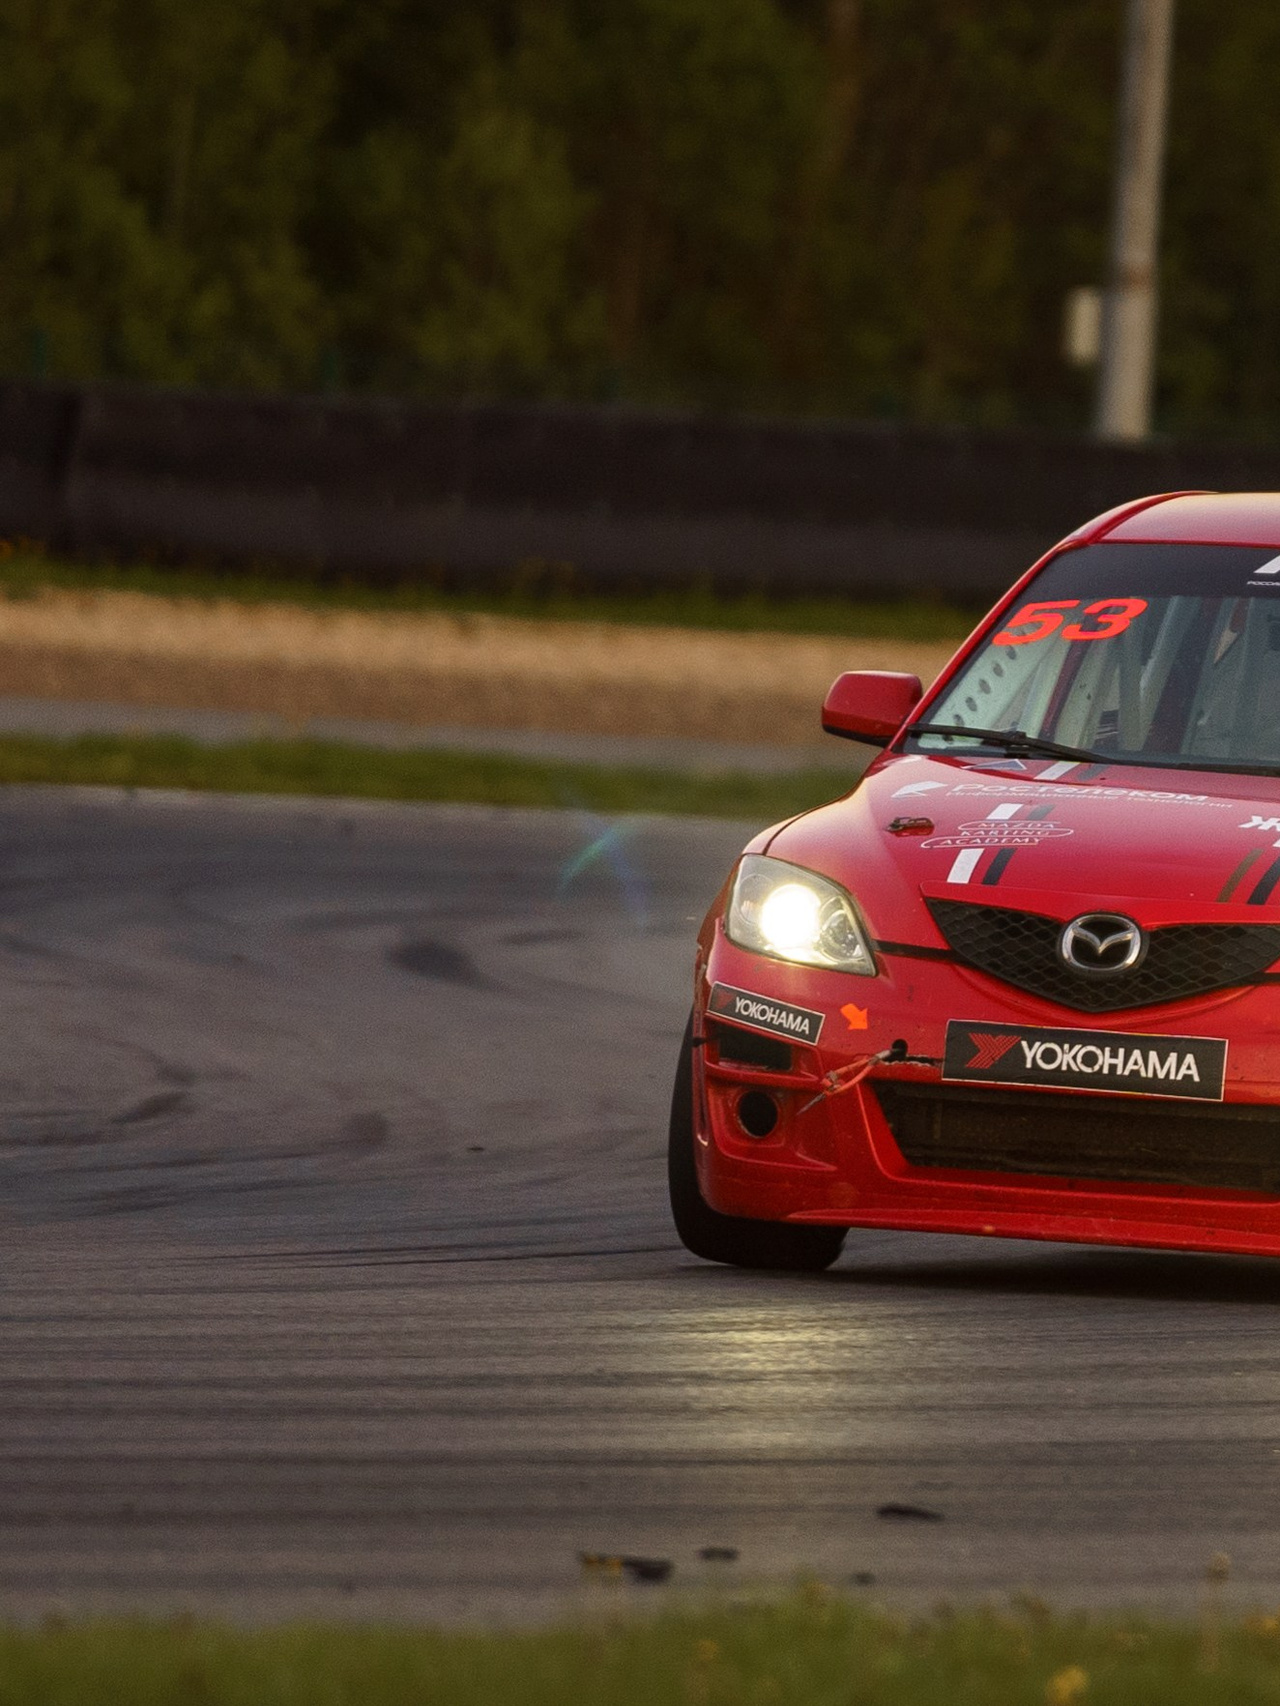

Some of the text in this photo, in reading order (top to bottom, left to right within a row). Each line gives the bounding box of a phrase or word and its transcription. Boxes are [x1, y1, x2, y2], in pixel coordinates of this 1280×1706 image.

[992, 598, 1149, 646] 53
[939, 837, 1042, 846] ACADEMY
[735, 996, 810, 1035] YOKOHAMA
[1020, 1040, 1201, 1083] YOKOHAMA
